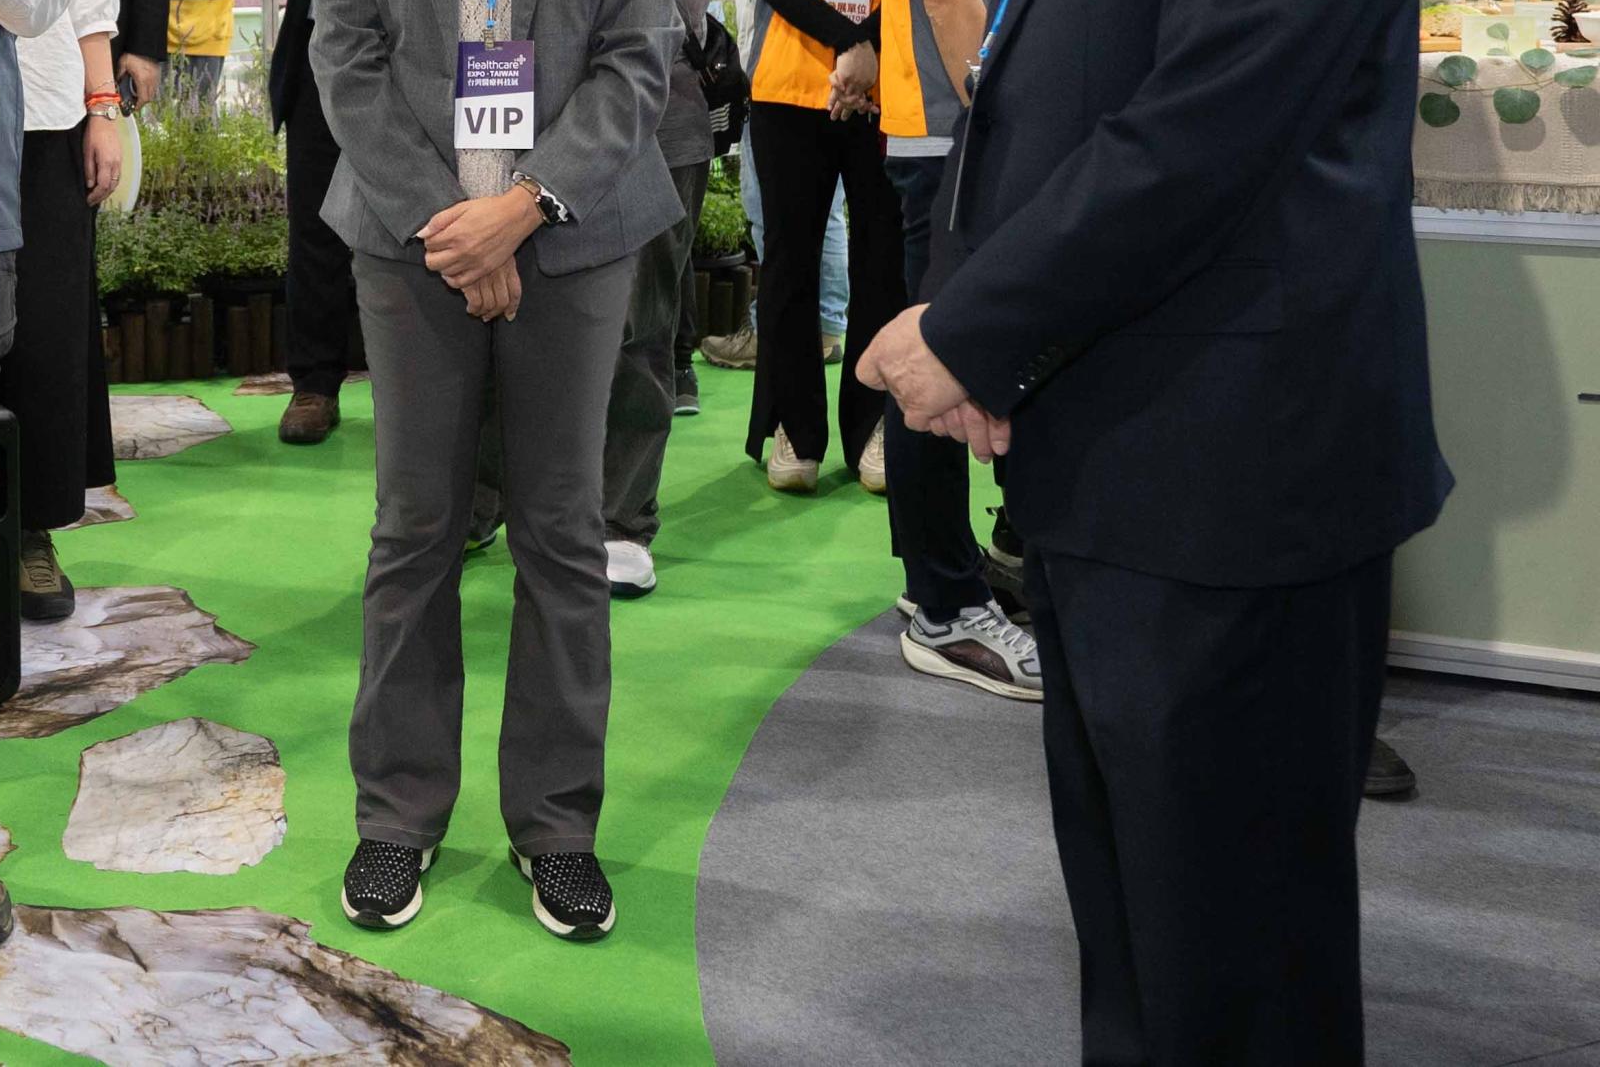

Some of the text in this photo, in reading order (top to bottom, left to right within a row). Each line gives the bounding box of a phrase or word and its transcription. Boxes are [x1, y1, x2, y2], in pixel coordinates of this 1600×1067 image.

[467, 60, 519, 69] Healthcare
[467, 70, 519, 78] EXPO TAIWAN
[464, 107, 524, 135] VIP
